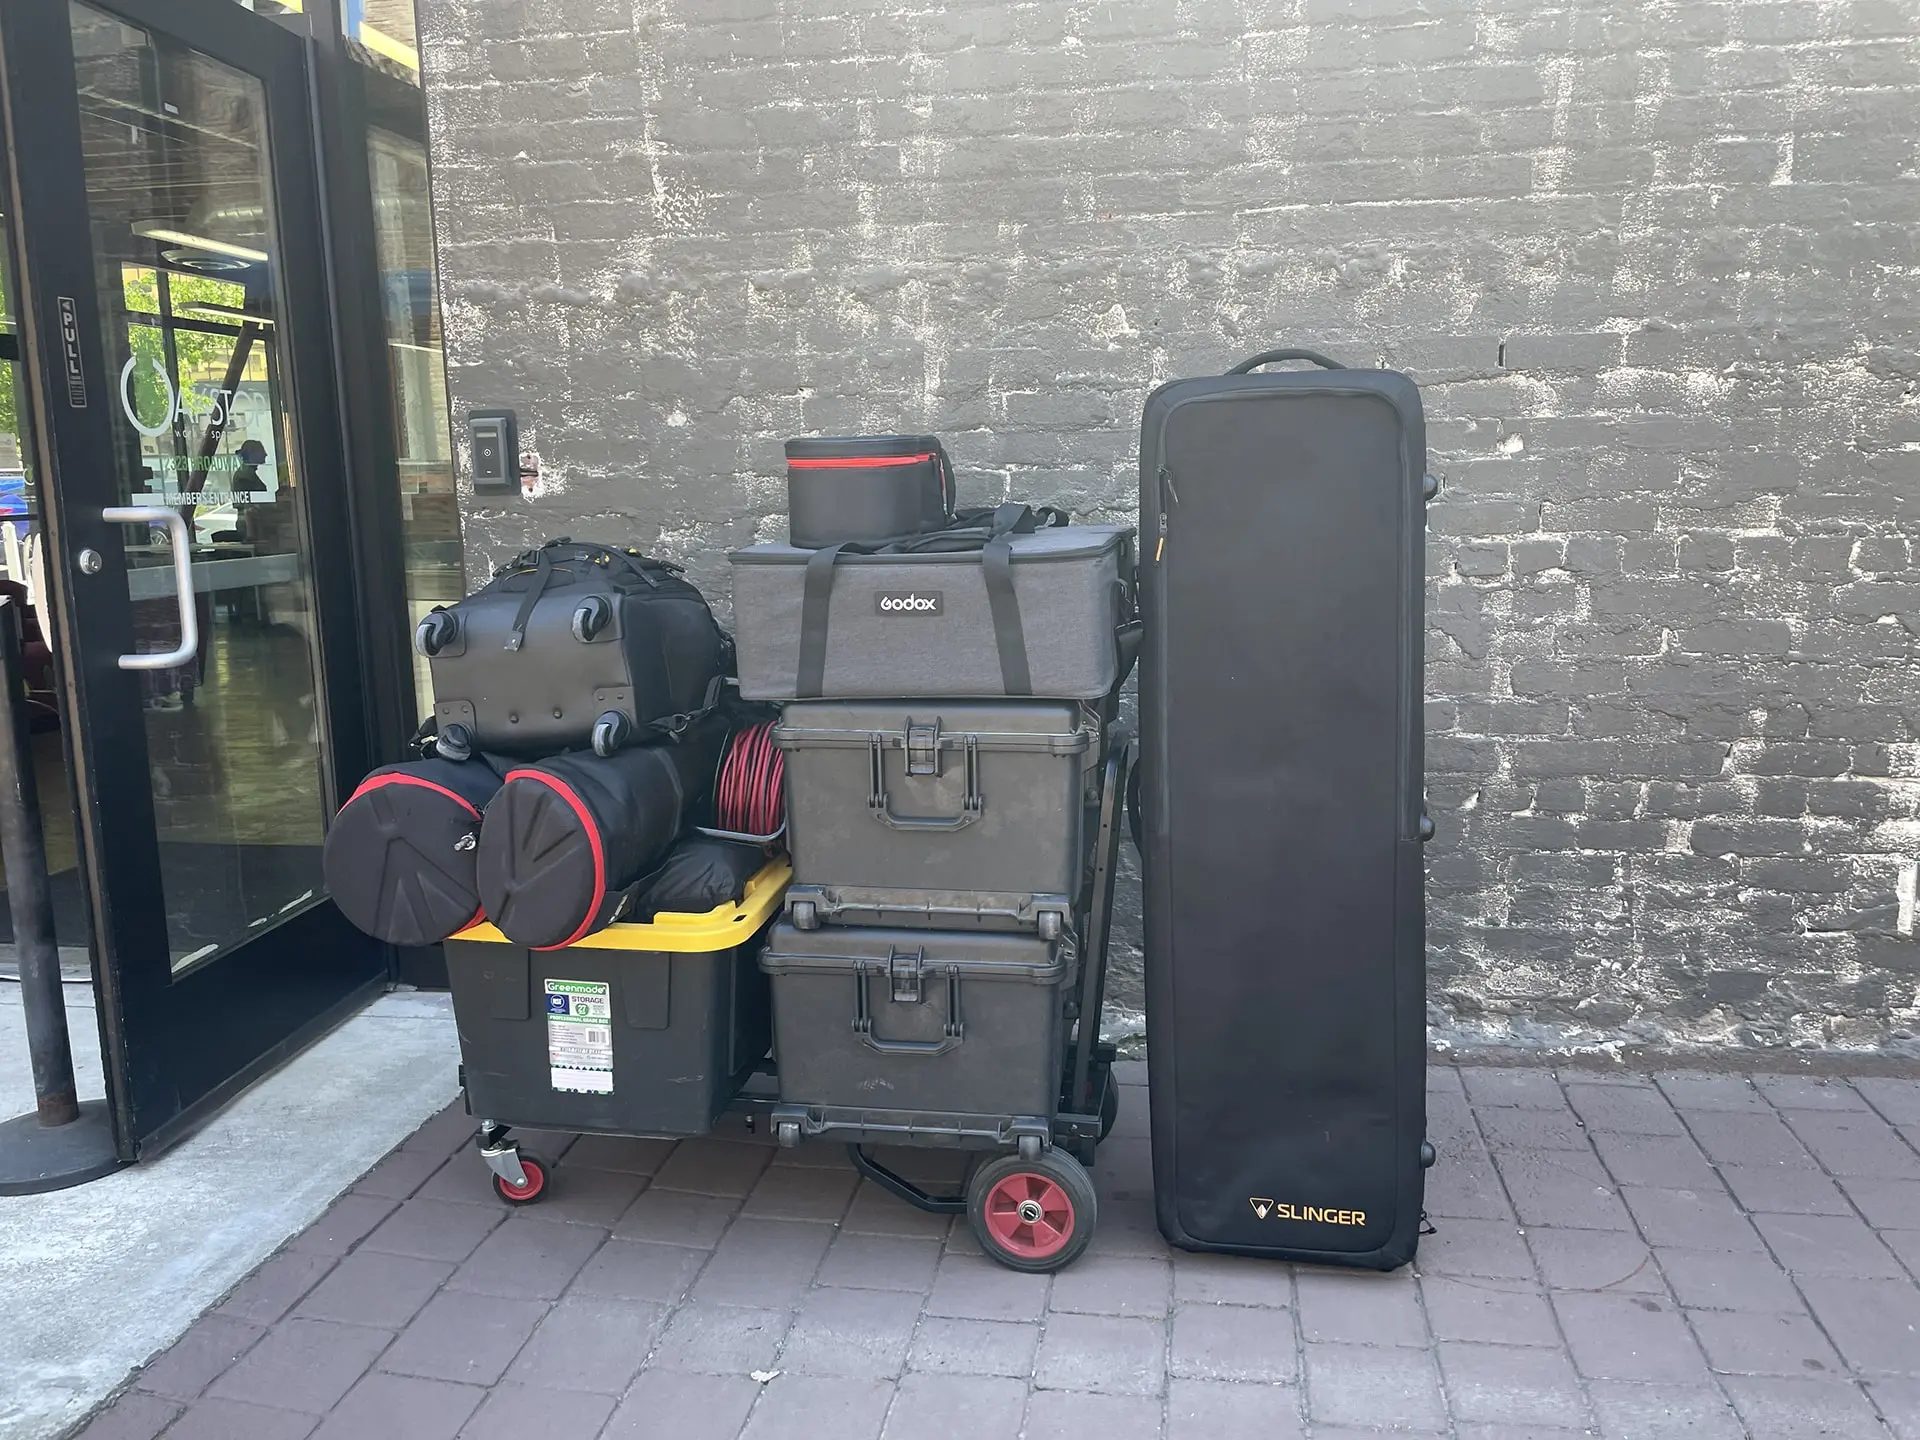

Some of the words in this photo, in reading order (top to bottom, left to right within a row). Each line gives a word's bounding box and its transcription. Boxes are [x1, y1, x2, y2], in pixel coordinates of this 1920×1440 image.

[63, 312, 79, 373] PULL
[191, 454, 244, 471] BROADWAY
[165, 491, 209, 506] MEMBERS
[880, 593, 937, 611] Godox
[571, 995, 605, 1005] STORAGE
[1277, 1203, 1366, 1226] SLINGER
